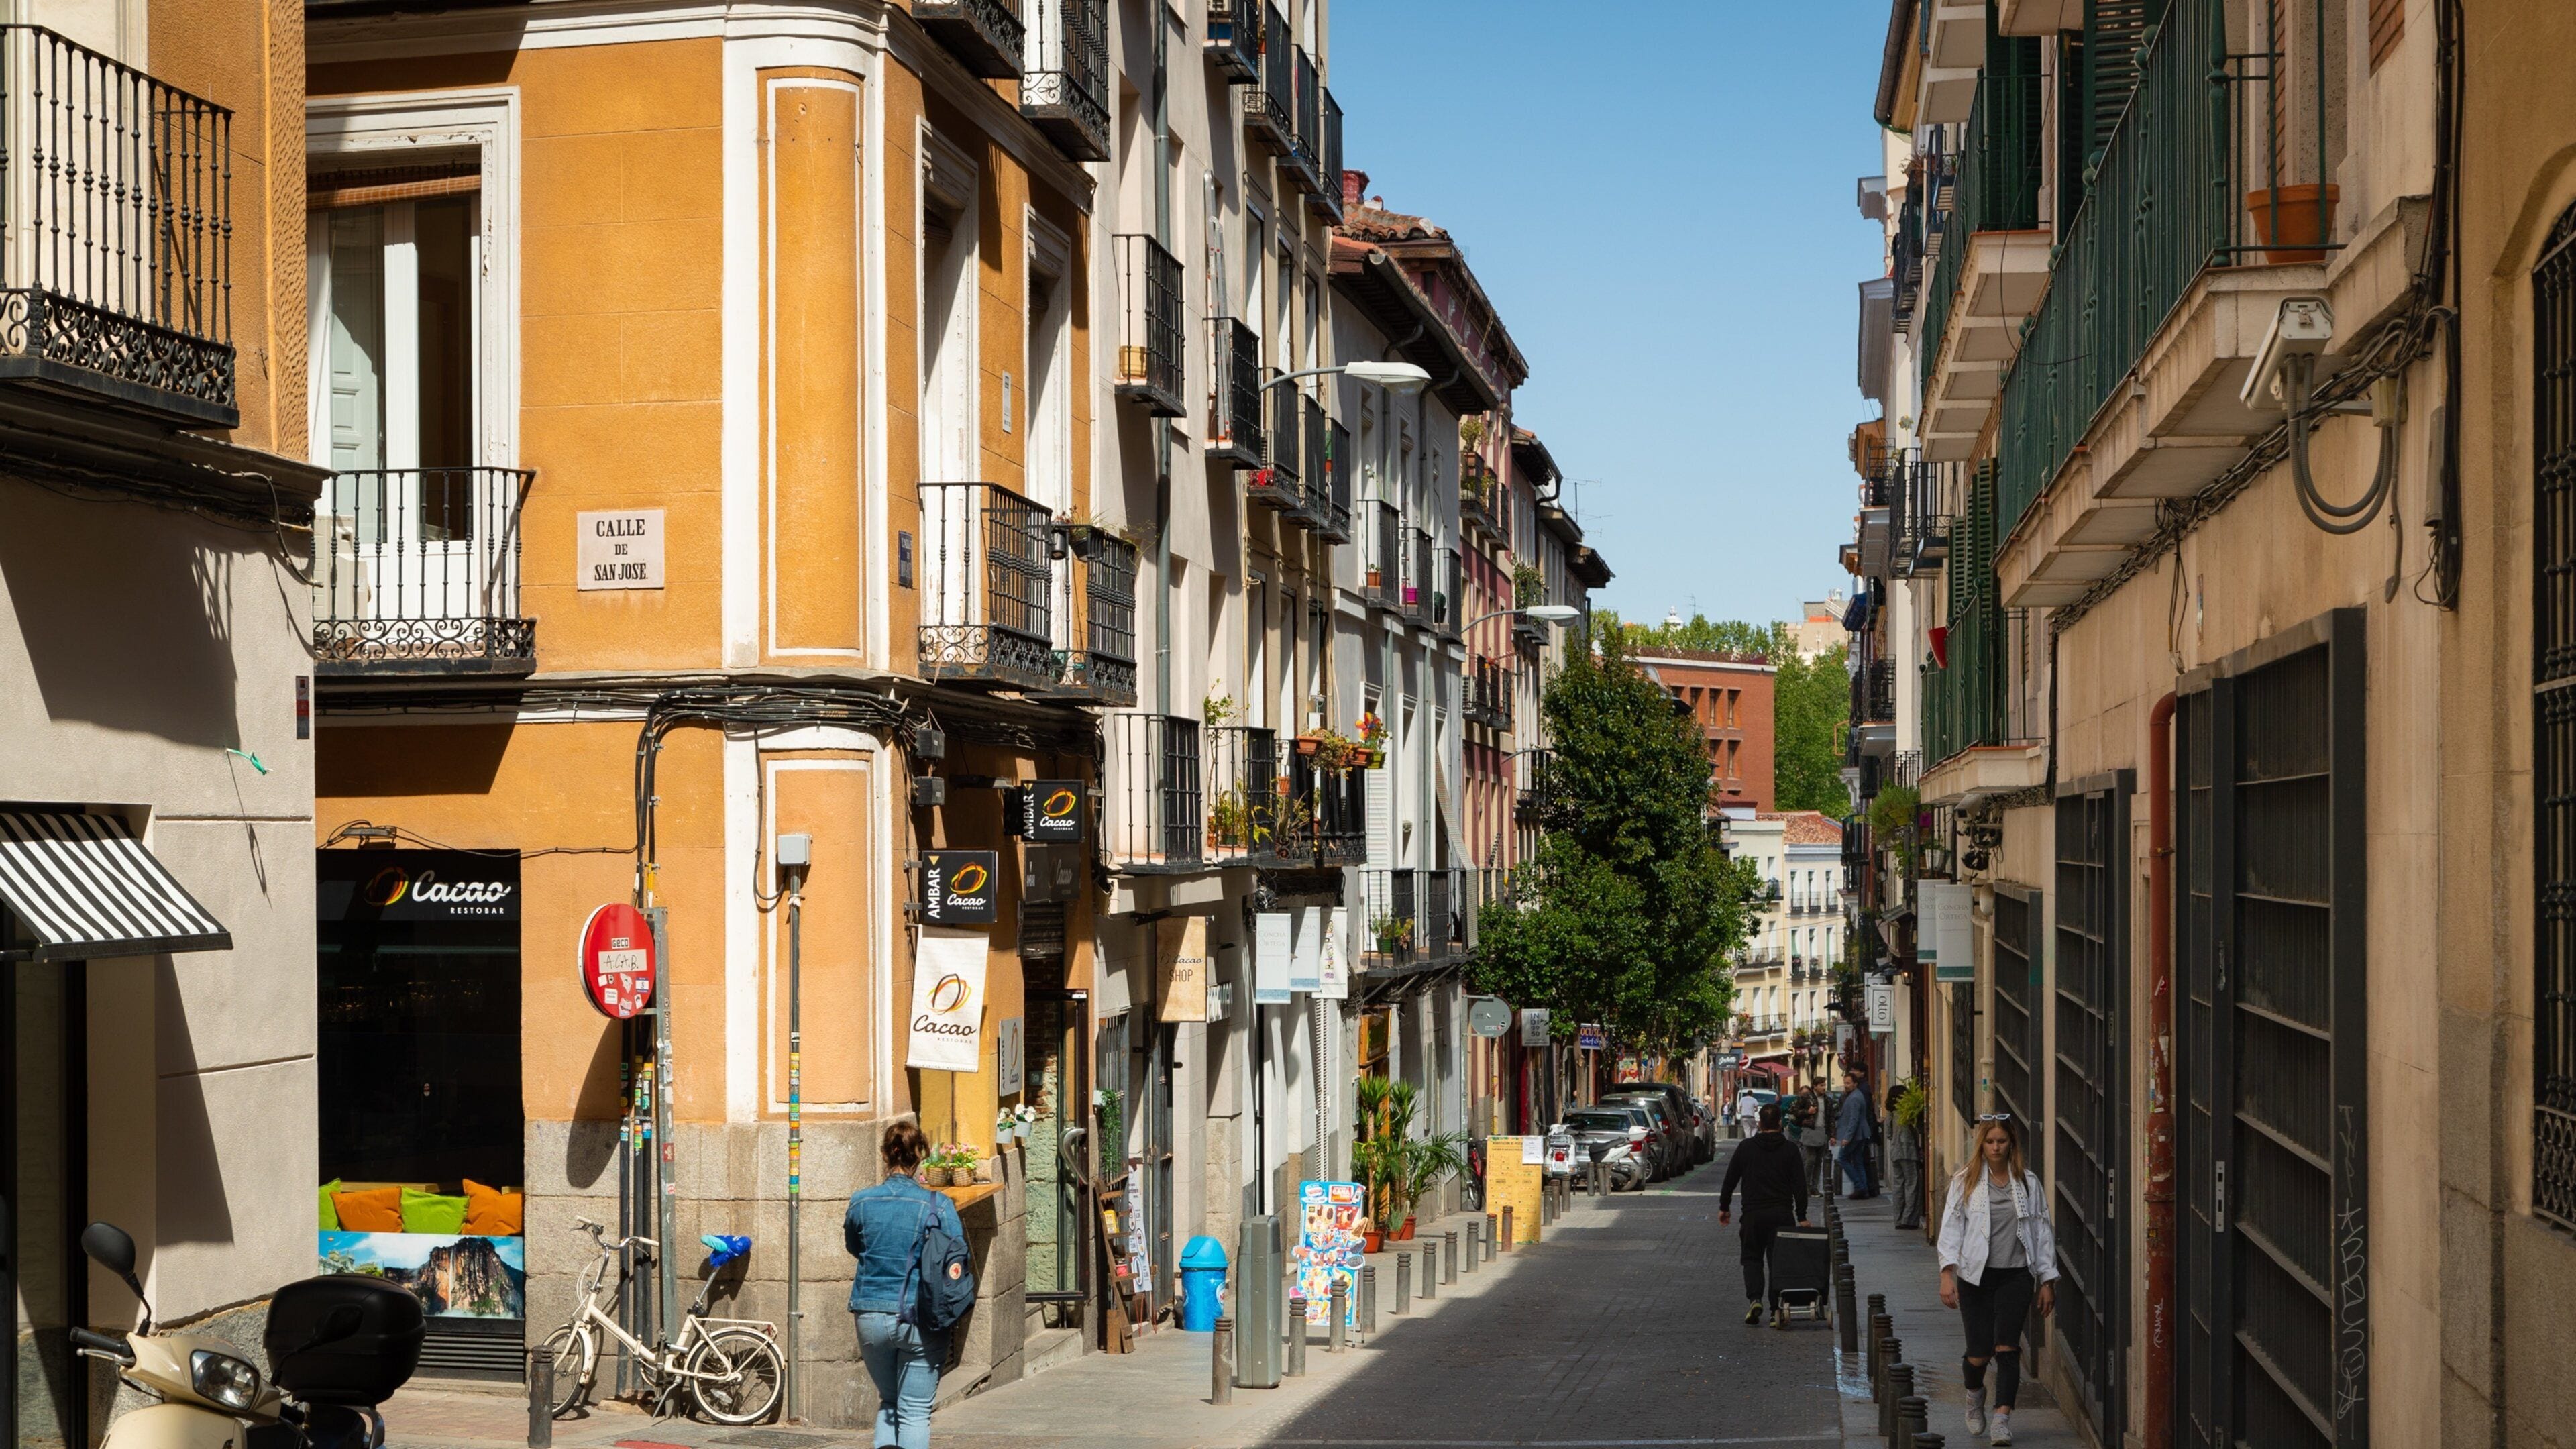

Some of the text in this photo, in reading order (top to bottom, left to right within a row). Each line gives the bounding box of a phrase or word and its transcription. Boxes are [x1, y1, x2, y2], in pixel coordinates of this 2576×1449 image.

[596, 519, 645, 537] CALLE
[614, 544, 628, 555] DE
[594, 564, 616, 582] SAN
[1024, 794, 1034, 839] AMBAR
[1040, 816, 1075, 828] Cacao
[412, 870, 511, 903] Cacao
[928, 868, 941, 919] AMBAR
[947, 894, 987, 906] Cacao
[1173, 955, 1203, 964] Cacao
[1169, 969, 1193, 982] SHOP
[913, 1014, 977, 1036] Cacao
